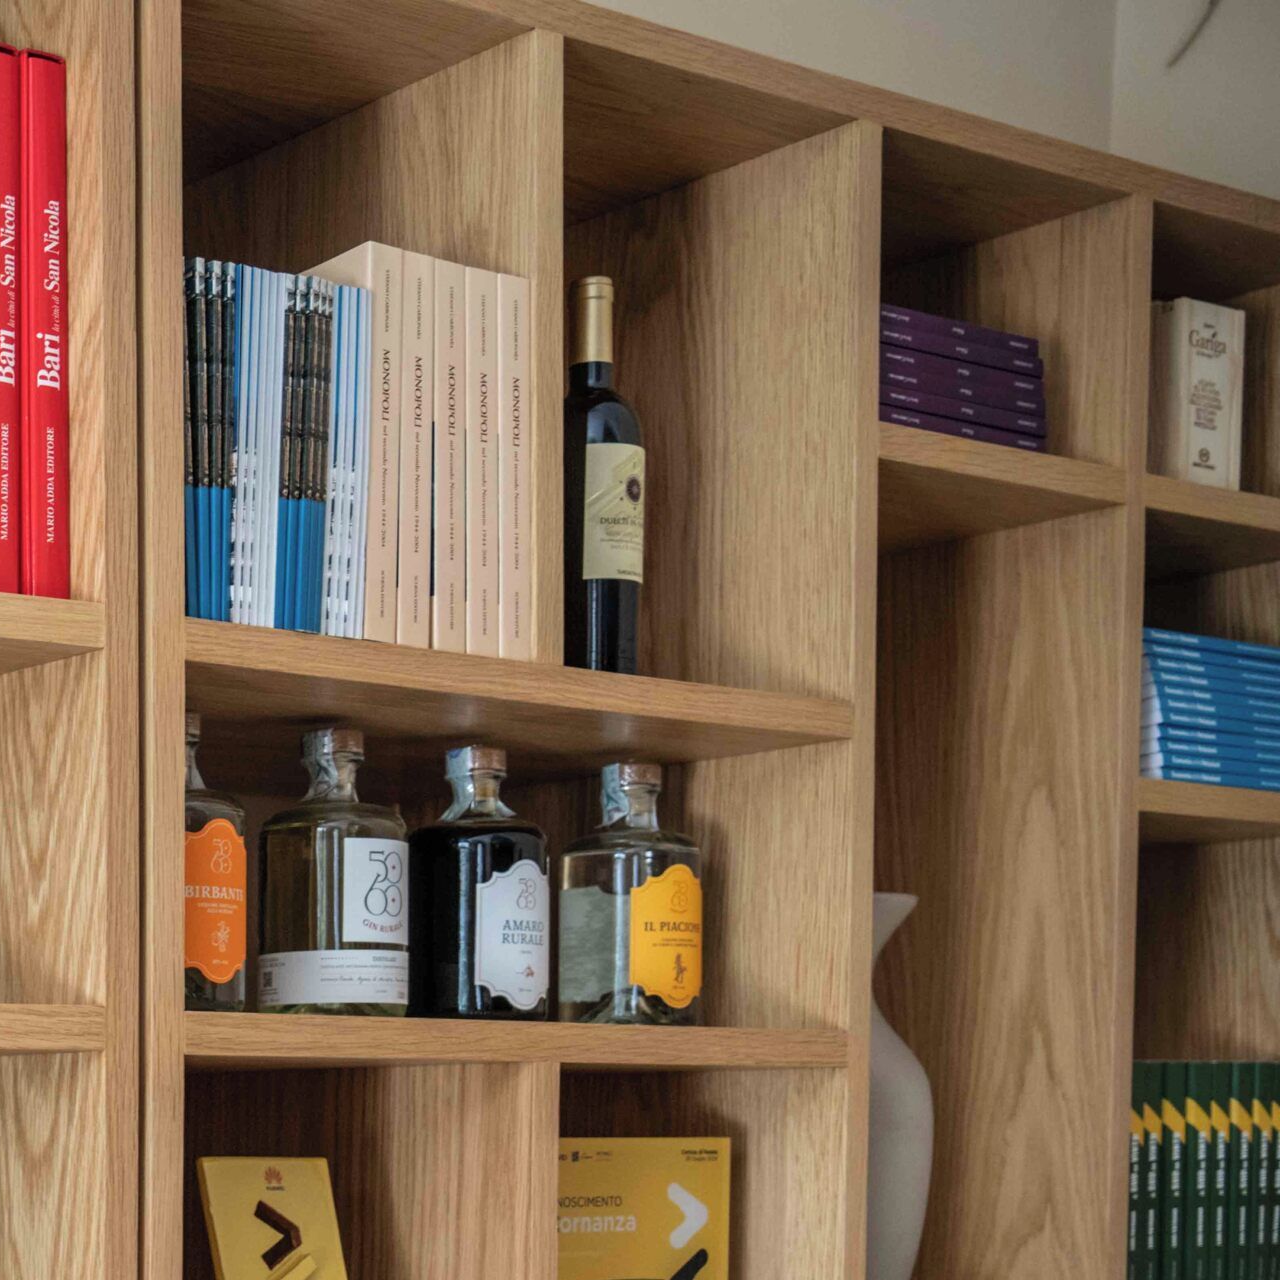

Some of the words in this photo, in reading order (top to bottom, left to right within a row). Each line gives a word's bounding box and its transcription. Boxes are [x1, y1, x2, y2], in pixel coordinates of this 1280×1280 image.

[0, 194, 16, 250] Nicola
[44, 200, 60, 256] Nicola
[0, 254, 16, 288] San
[44, 259, 60, 293] San
[36, 332, 60, 391] Bari
[382, 349, 391, 421] MONOPOLI
[414, 356, 422, 428] MONOPOLI
[448, 364, 456, 436] MONOPOLI
[480, 372, 488, 443] MONOPOLI
[512, 377, 521, 447] MONOPOLI
[363, 919, 378, 931] GIN
[501, 933, 544, 945] RURALE
[502, 920, 544, 932] AMARO
[644, 922, 656, 931] IL
[558, 1196, 622, 1208] NOSCIMENTO
